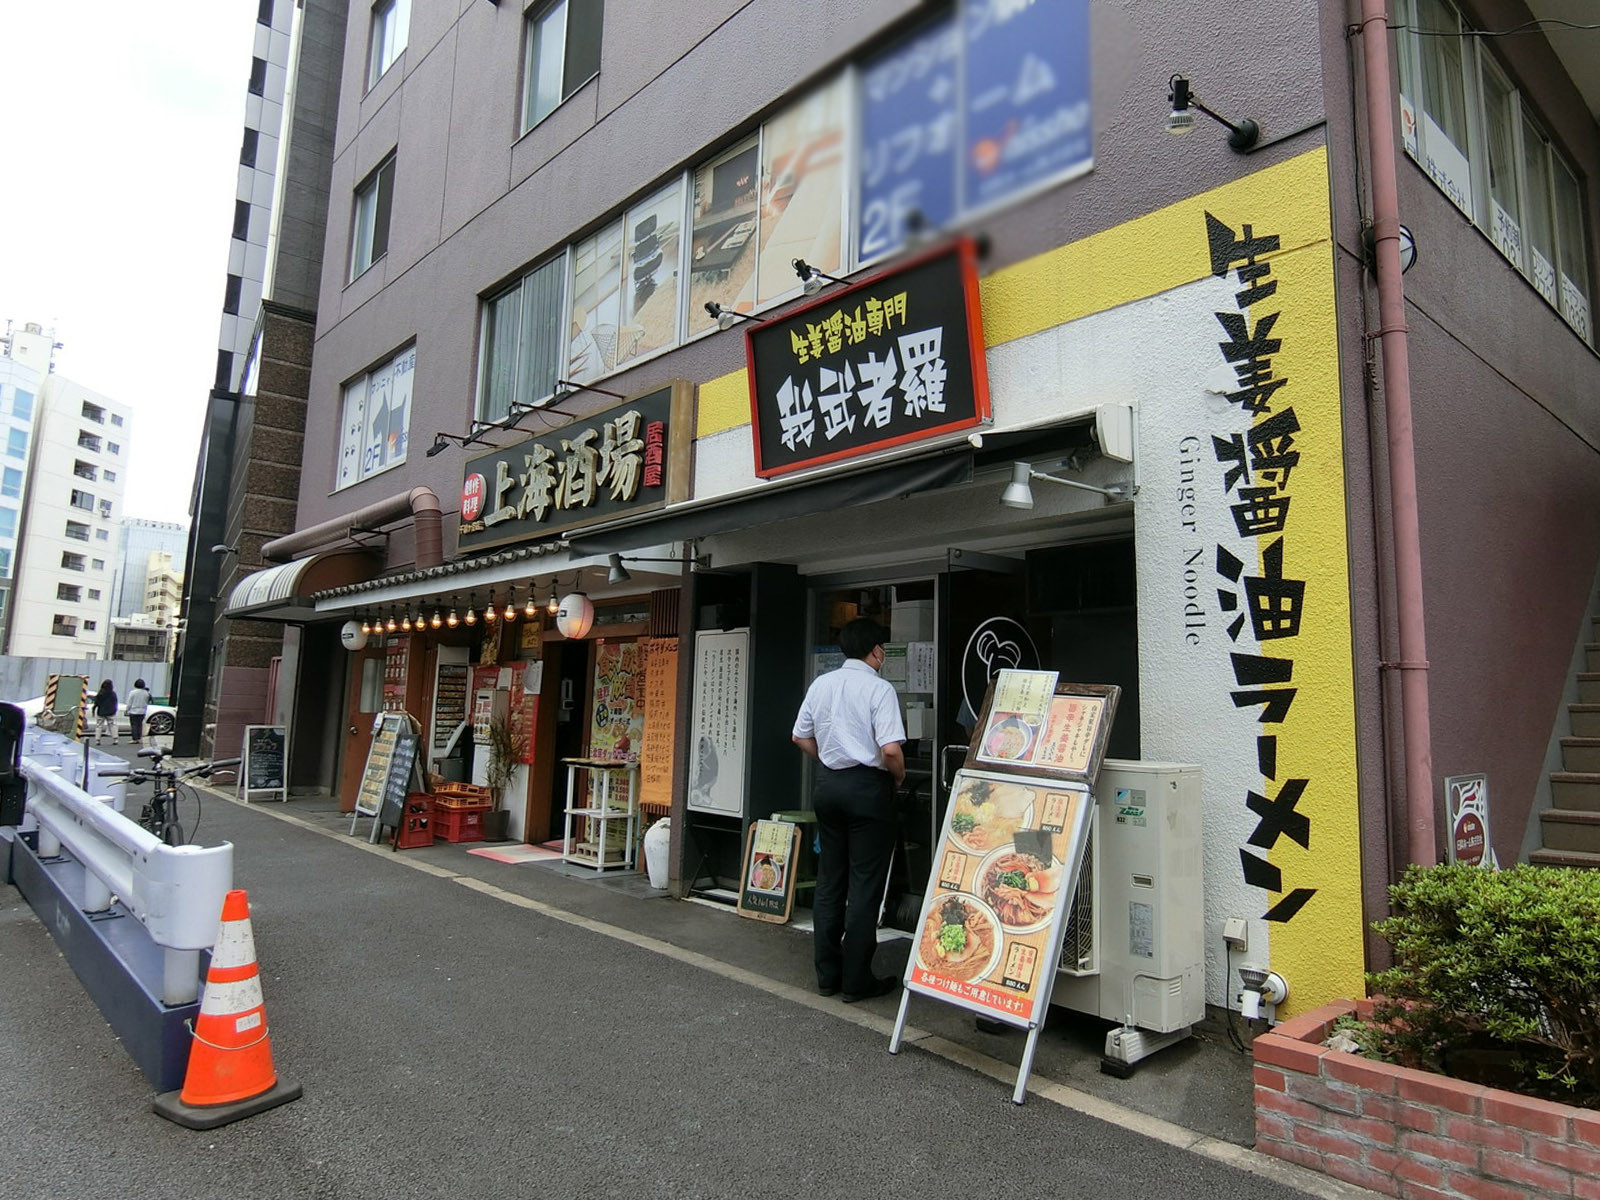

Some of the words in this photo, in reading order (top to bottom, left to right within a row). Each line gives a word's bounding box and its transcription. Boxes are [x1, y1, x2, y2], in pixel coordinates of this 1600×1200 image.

[790, 291, 908, 365] 生姜醤油専門
[776, 326, 948, 452] 我武者羅
[364, 443, 381, 474] 2F
[484, 410, 645, 528] 上海酒場
[1176, 436, 1201, 533] Ginger
[1183, 548, 1207, 646] Noodle
[1204, 210, 1318, 923] 生姜醤油ラーメン
